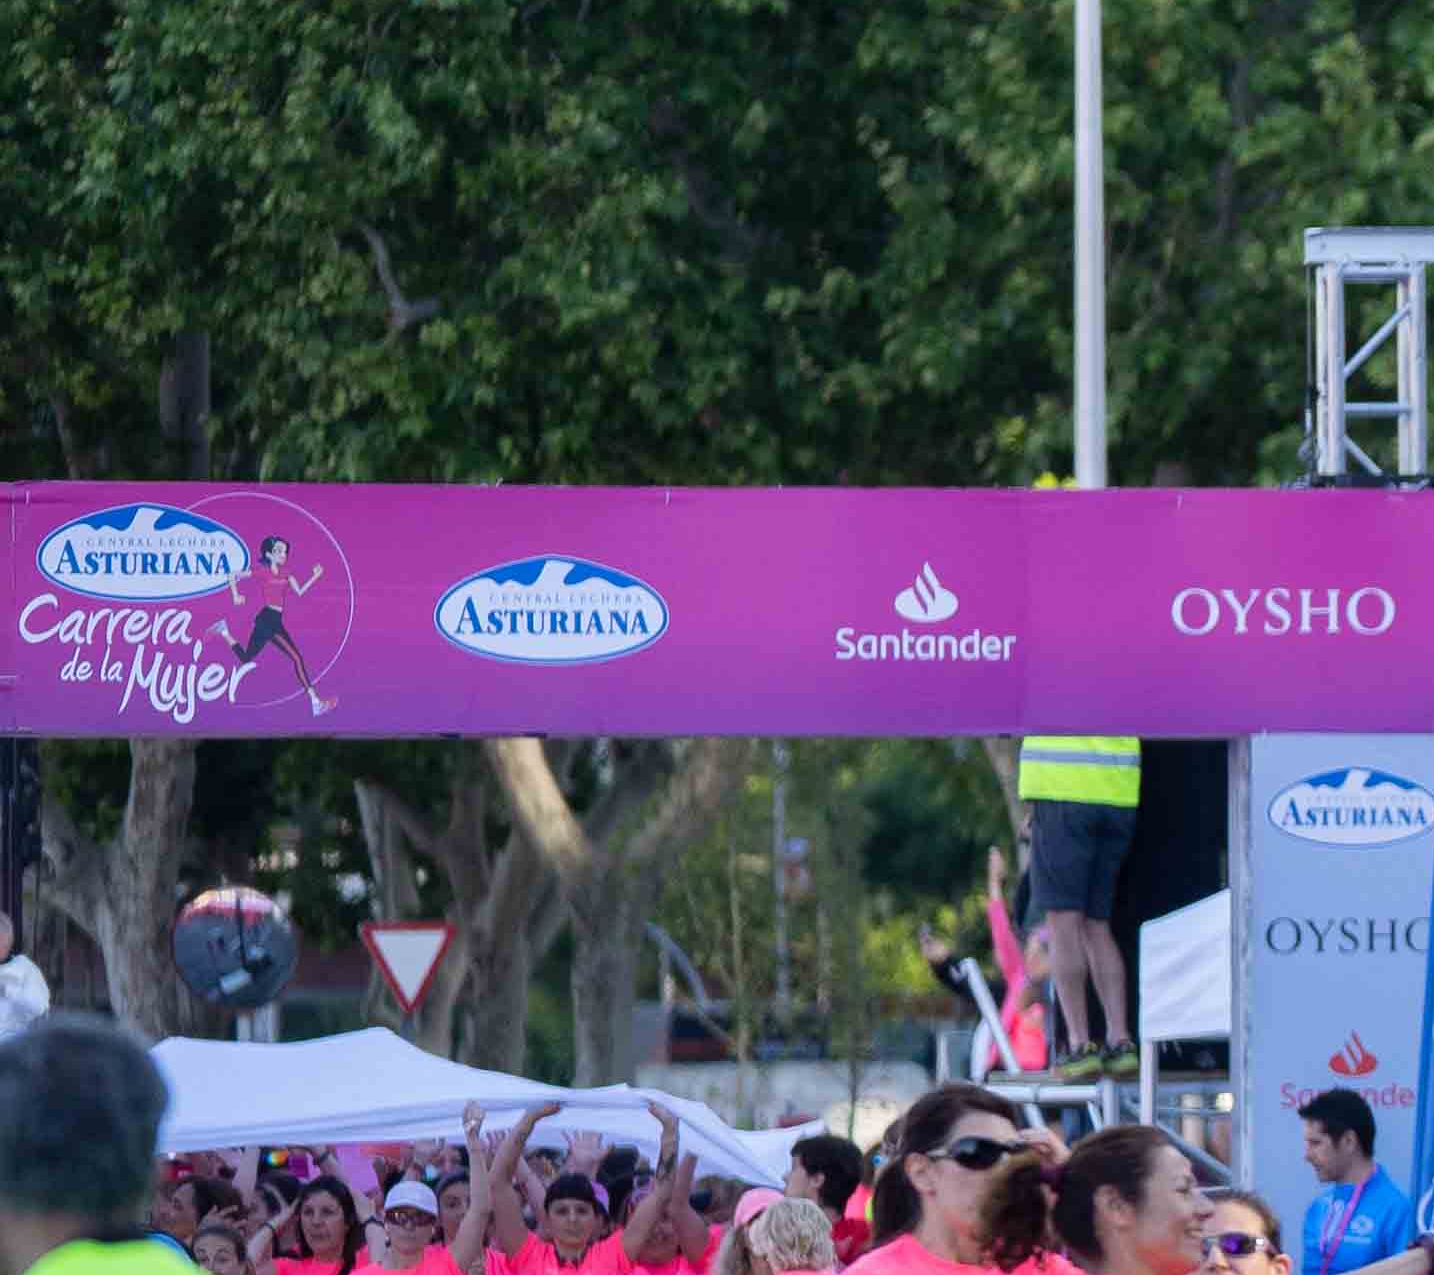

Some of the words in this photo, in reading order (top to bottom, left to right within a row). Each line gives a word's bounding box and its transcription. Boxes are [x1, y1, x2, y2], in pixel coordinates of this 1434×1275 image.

[54, 539, 233, 576] ASTURIANA
[19, 593, 194, 645] Carrera
[454, 596, 649, 636] ASTURIANA
[1171, 586, 1397, 636] OYSHO
[835, 627, 1017, 662] Santander
[60, 646, 92, 683] de
[100, 645, 122, 682] la
[118, 639, 257, 724] Mujer
[1281, 798, 1428, 827] ASTURIANA
